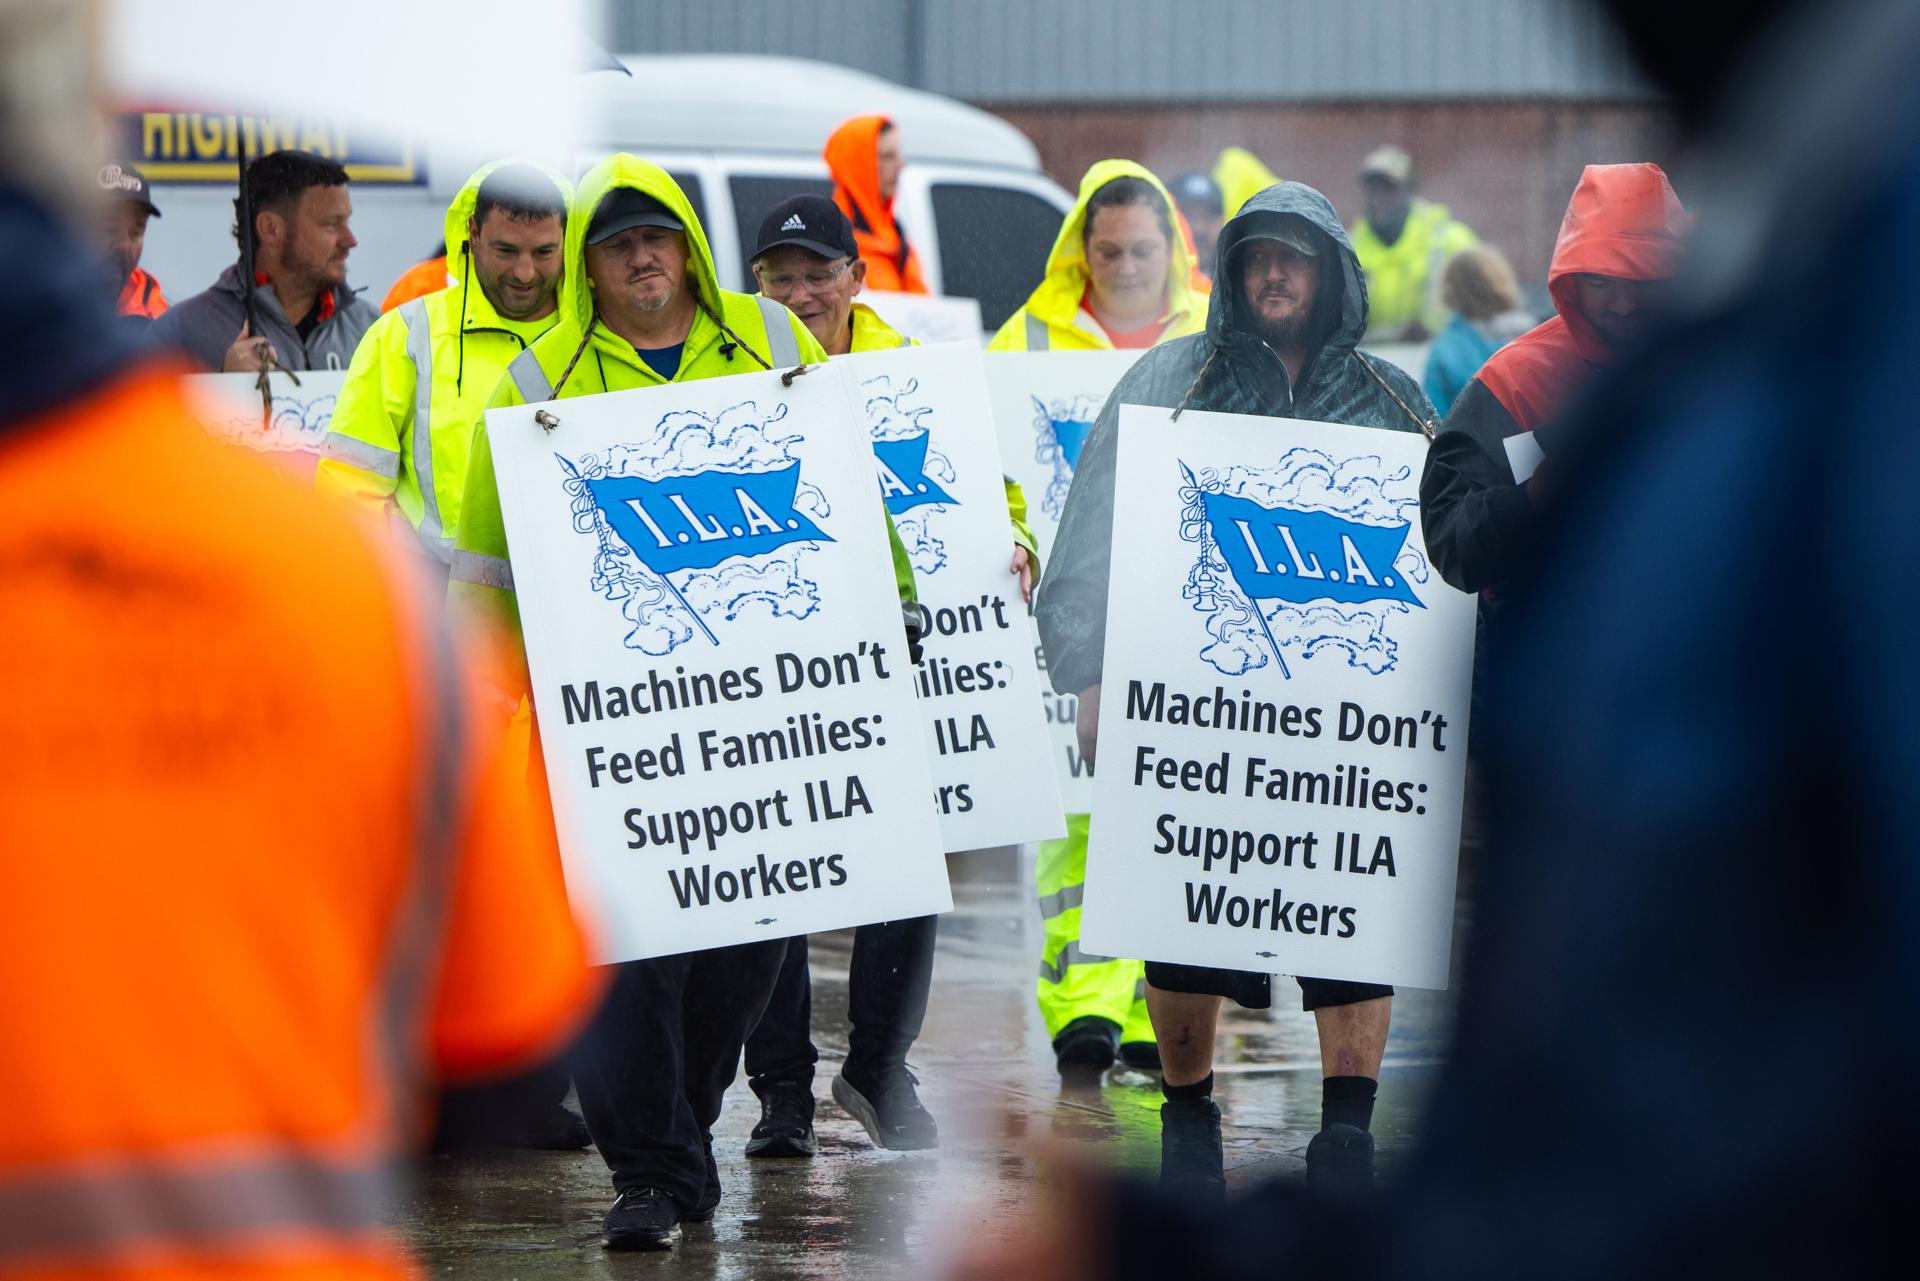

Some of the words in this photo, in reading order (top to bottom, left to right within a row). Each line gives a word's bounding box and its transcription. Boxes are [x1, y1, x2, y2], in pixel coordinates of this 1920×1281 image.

[623, 487, 800, 549] I.L.A.
[1232, 518, 1396, 588] I.L.A.
[560, 665, 763, 725] Machines
[775, 641, 890, 694] Don't
[912, 657, 1007, 699] ilies:
[934, 714, 996, 756] ILA
[1126, 679, 1323, 739] Machines
[1337, 701, 1449, 753] Don't
[585, 732, 686, 789] Feed
[698, 712, 886, 772] Families:
[1134, 745, 1230, 795] Feed
[1244, 757, 1428, 816] Families:
[623, 789, 793, 856] Support
[804, 775, 874, 823] ILA
[1153, 813, 1319, 875] Support
[1333, 831, 1397, 878] ILA
[667, 852, 848, 909] Workers
[1184, 881, 1357, 939] Workers
